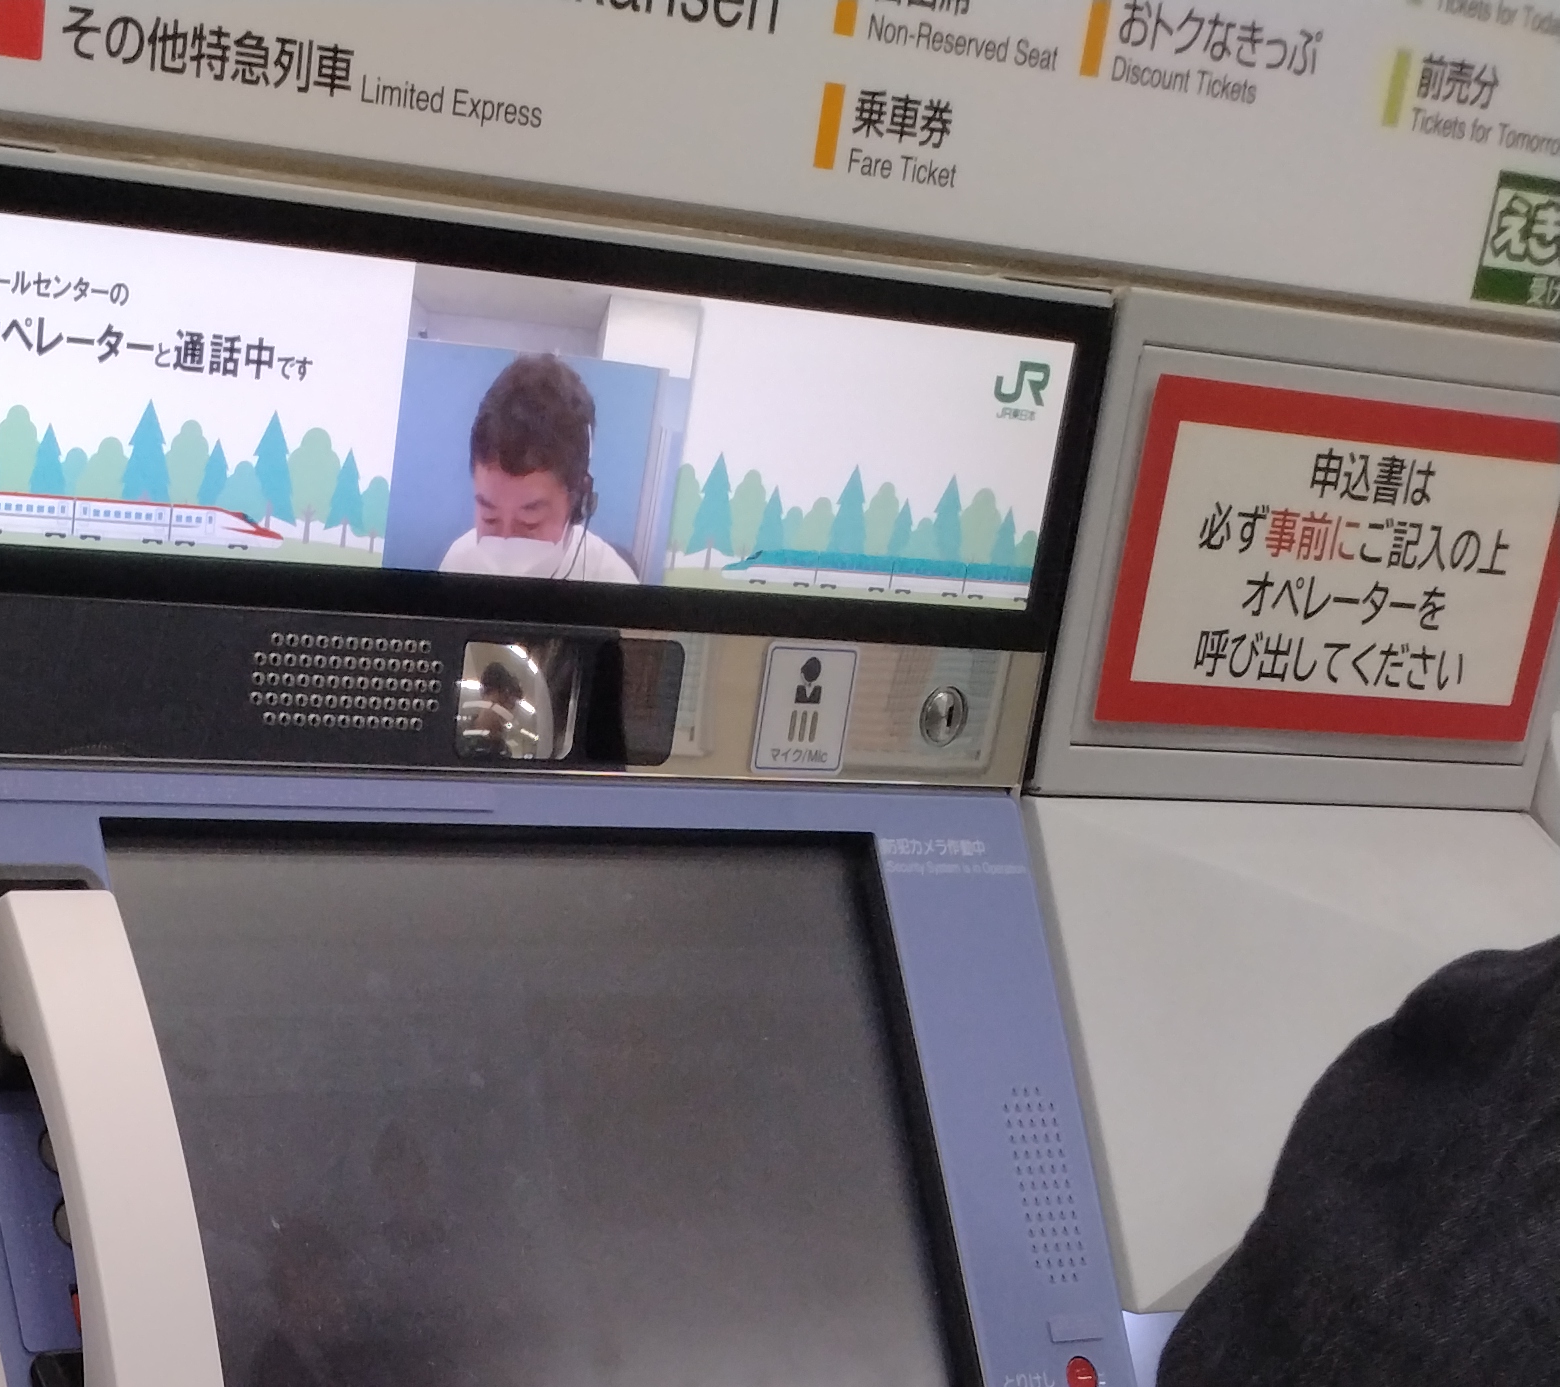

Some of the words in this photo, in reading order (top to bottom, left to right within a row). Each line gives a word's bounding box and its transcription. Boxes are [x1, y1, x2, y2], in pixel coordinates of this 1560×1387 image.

[61, 5, 356, 97] その他特急列車
[868, 13, 1010, 68] Non-Reserved
[1016, 41, 1059, 72] Seat
[1118, 1, 1324, 76] おトクなきっぷ
[361, 74, 443, 115] Limited
[452, 88, 543, 130] Express
[1111, 56, 1191, 95] Discount
[1196, 69, 1258, 105] Tickets
[1417, 52, 1500, 110] 前売分
[854, 90, 953, 149] 乗車券
[1411, 106, 1467, 140] Tickets
[1470, 118, 1493, 145] for
[847, 149, 892, 179] Fare
[899, 155, 958, 188] Ticket
[993, 360, 1051, 407] JR
[1308, 447, 1437, 507] 申込書は
[1197, 500, 1511, 577] 必ず事前にご記入の上
[1241, 570, 1447, 632] オペレーターを
[1192, 628, 1465, 692] 呼び出してください
